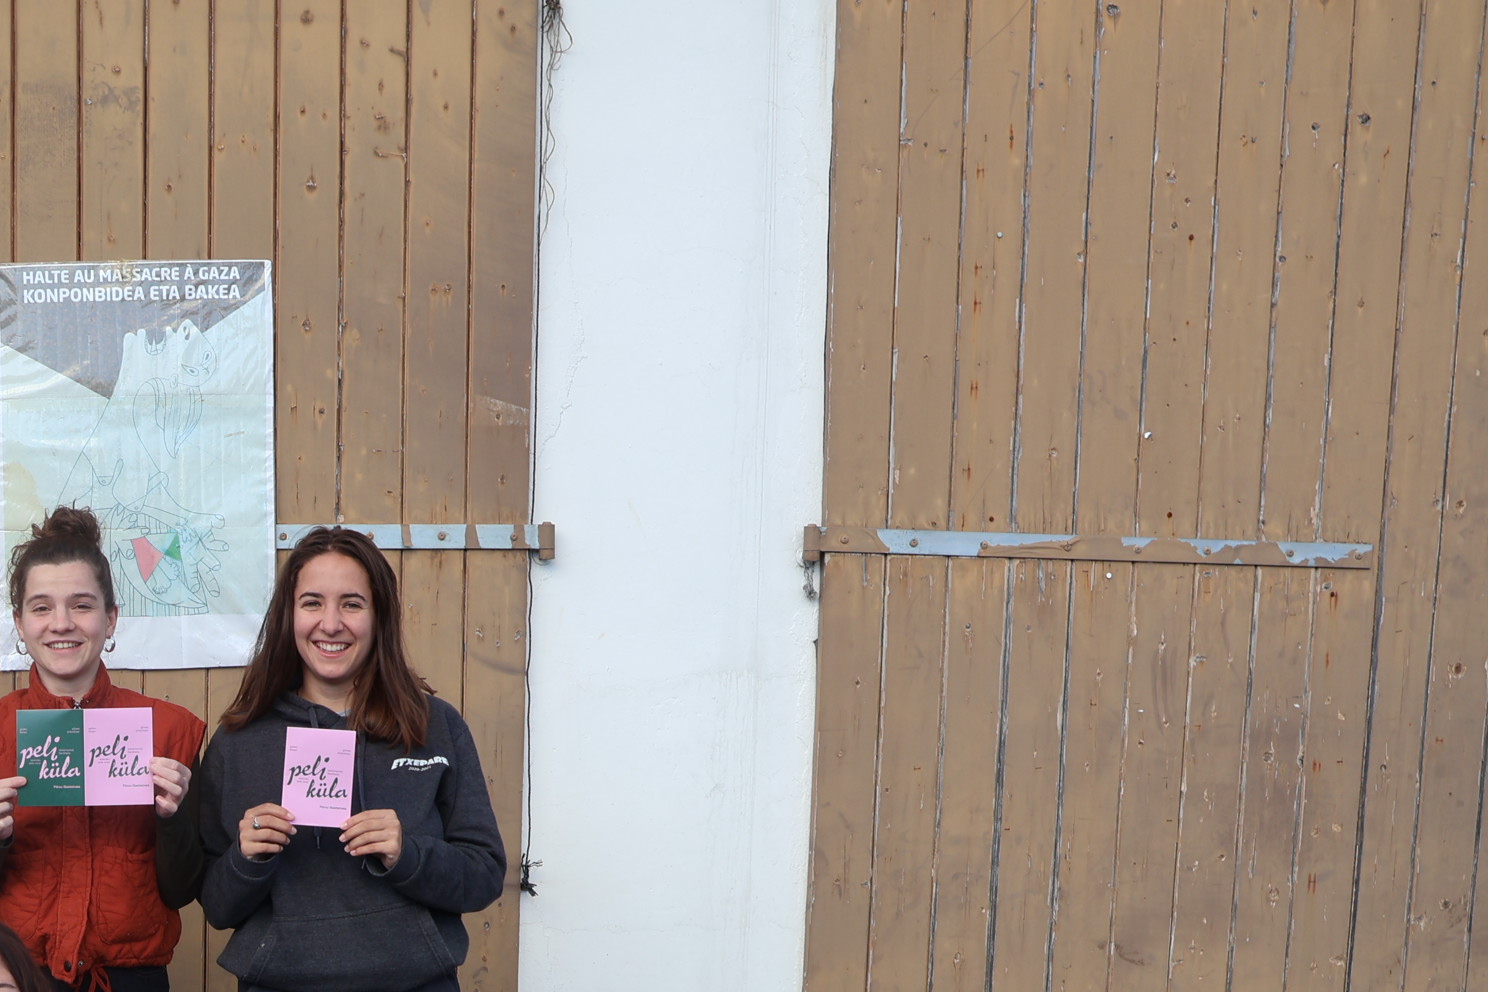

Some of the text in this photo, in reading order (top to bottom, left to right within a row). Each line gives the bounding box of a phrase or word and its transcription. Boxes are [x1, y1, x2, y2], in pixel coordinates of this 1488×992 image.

[23, 264, 240, 284] HALTE AU MASSACRE À GAZA
[23, 284, 241, 304] KONPONBIDEA ETA BAKEA
[19, 734, 61, 769] peli
[89, 734, 129, 767] peli
[39, 756, 81, 780] küla
[108, 755, 149, 779] küla
[287, 755, 330, 785] peli
[306, 777, 348, 799] küla
